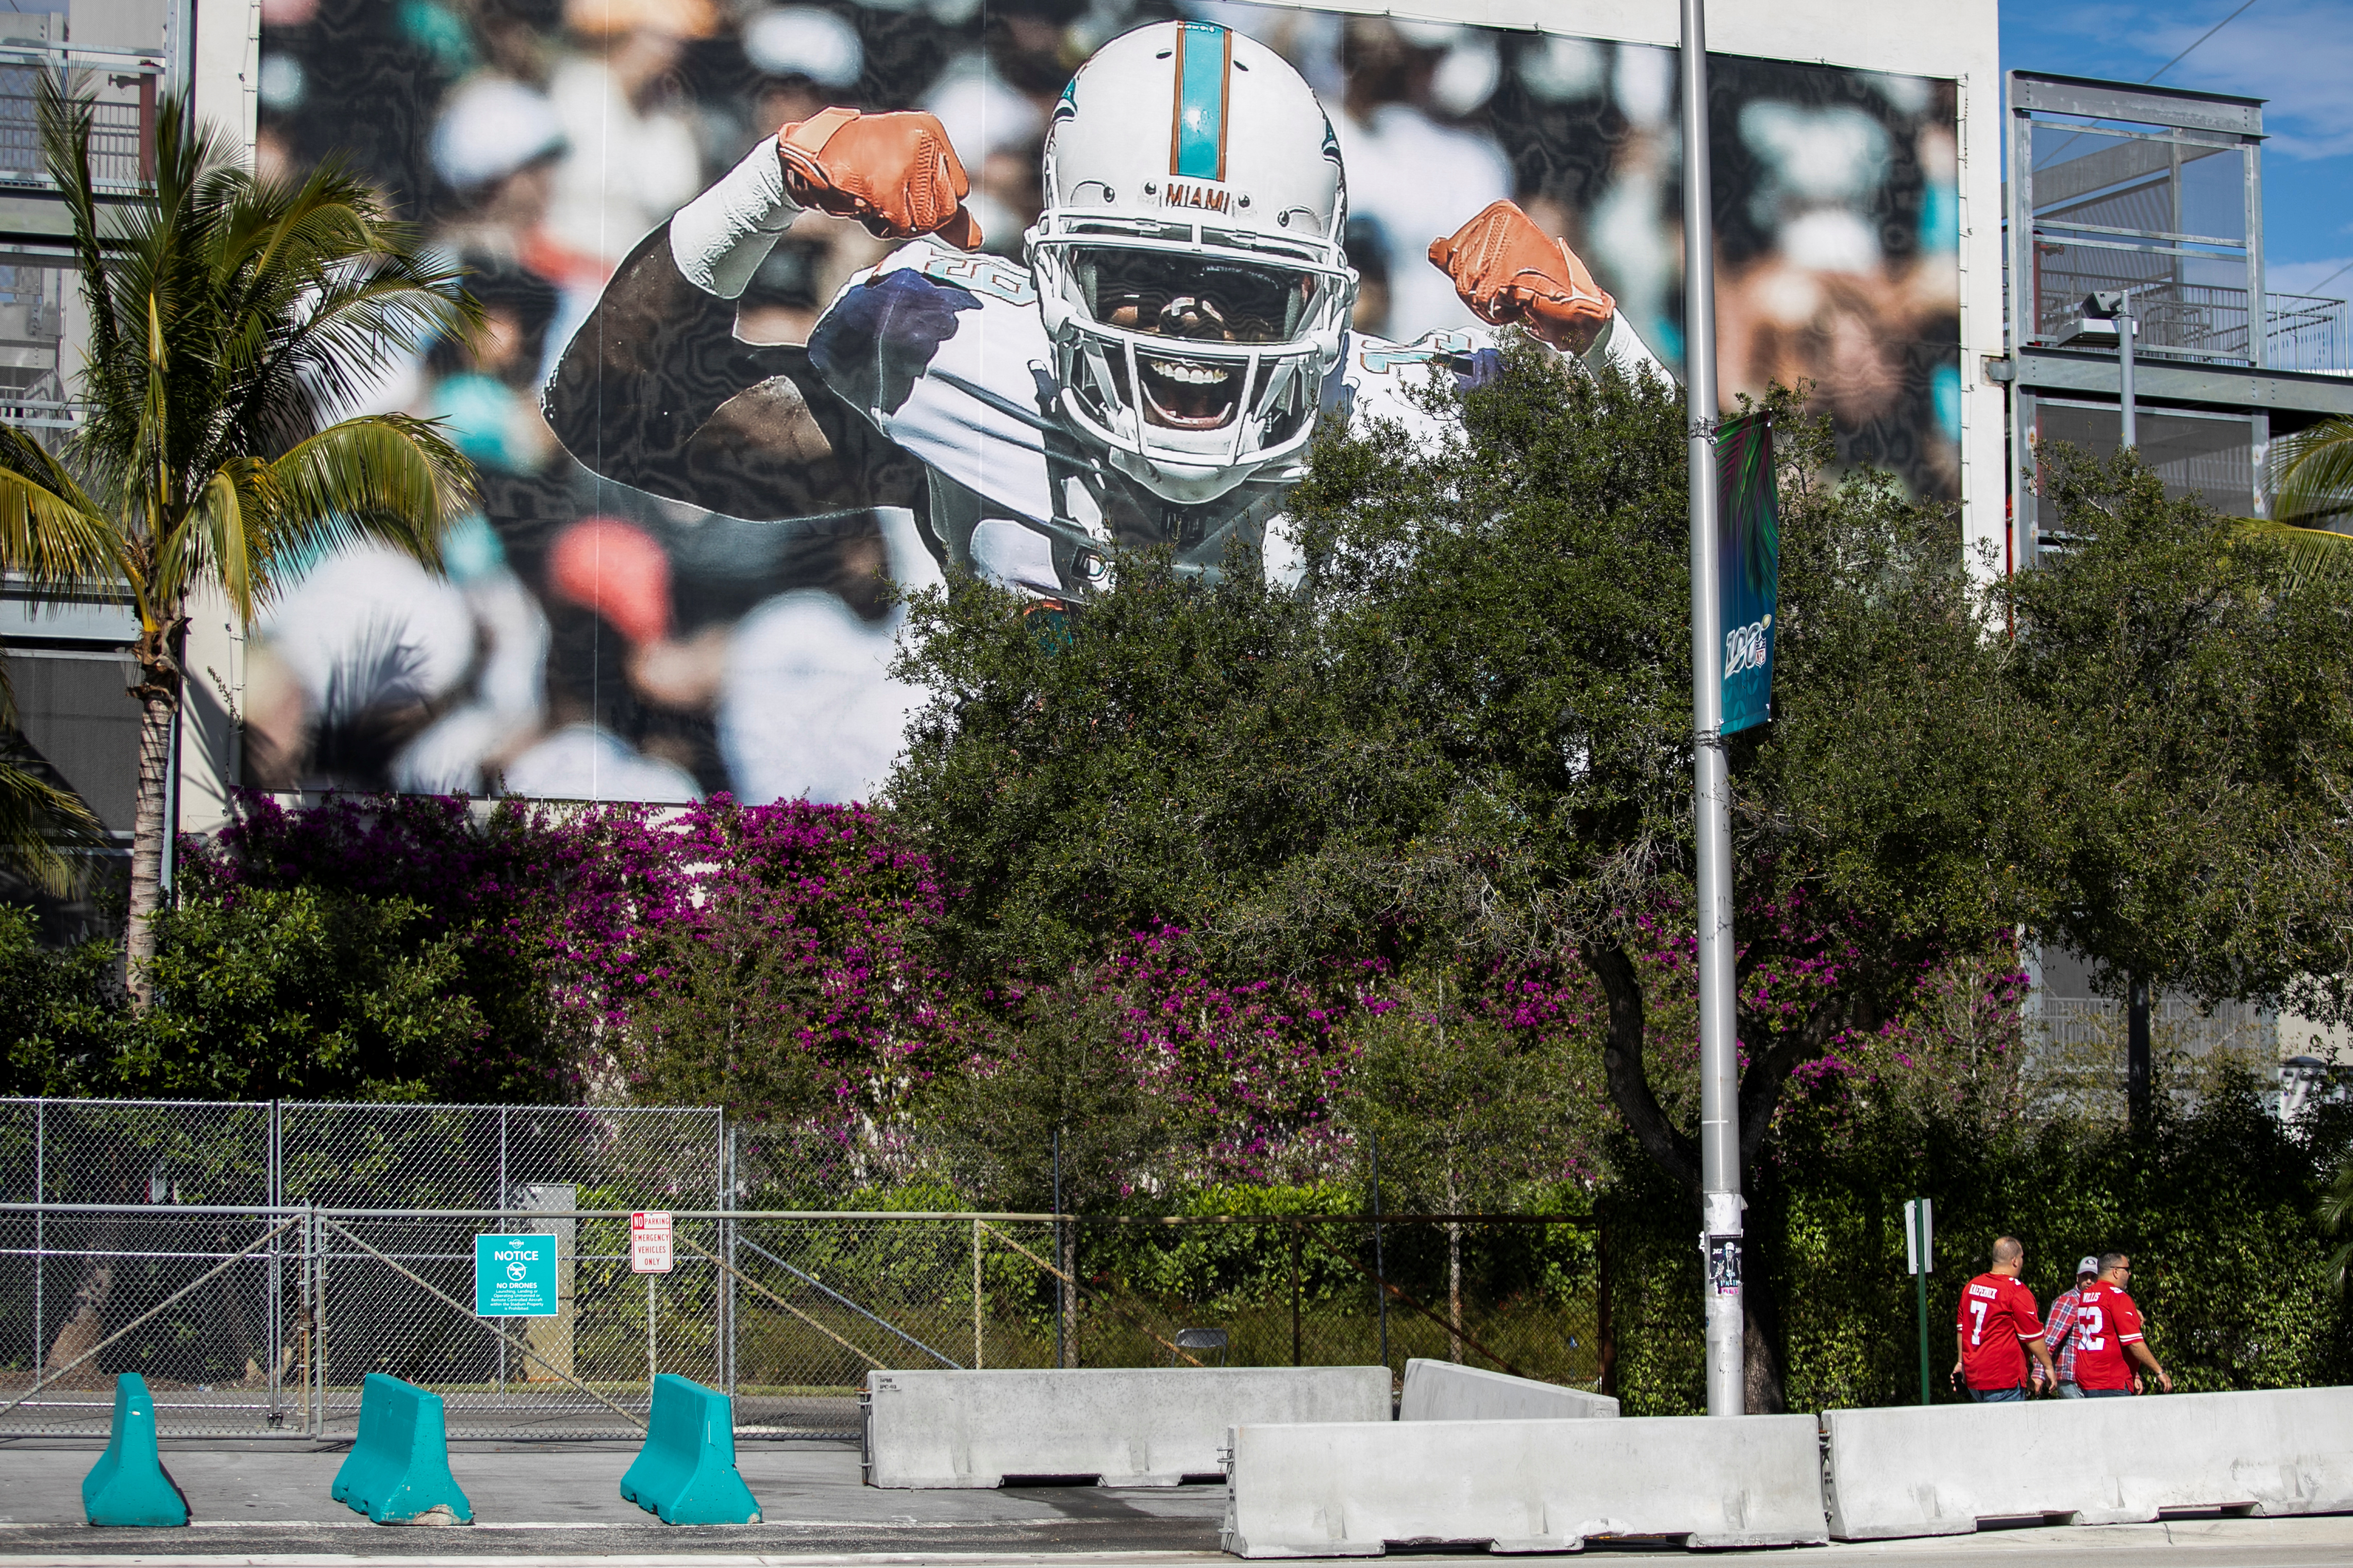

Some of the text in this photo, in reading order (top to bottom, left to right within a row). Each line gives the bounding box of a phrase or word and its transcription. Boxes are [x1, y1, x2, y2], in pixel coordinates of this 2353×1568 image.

[1166, 183, 1230, 214] MIAMI
[1756, 649, 1765, 663] NFL
[634, 1216, 643, 1227] NO
[635, 1234, 669, 1242] EMERGENCY
[494, 1251, 539, 1261] NOTICE
[1969, 1283, 1998, 1300] KAEPERNICK
[2082, 1292, 2101, 1303] WILLIS
[1970, 1300, 1988, 1345] 7
[2077, 1306, 2105, 1351] 52
